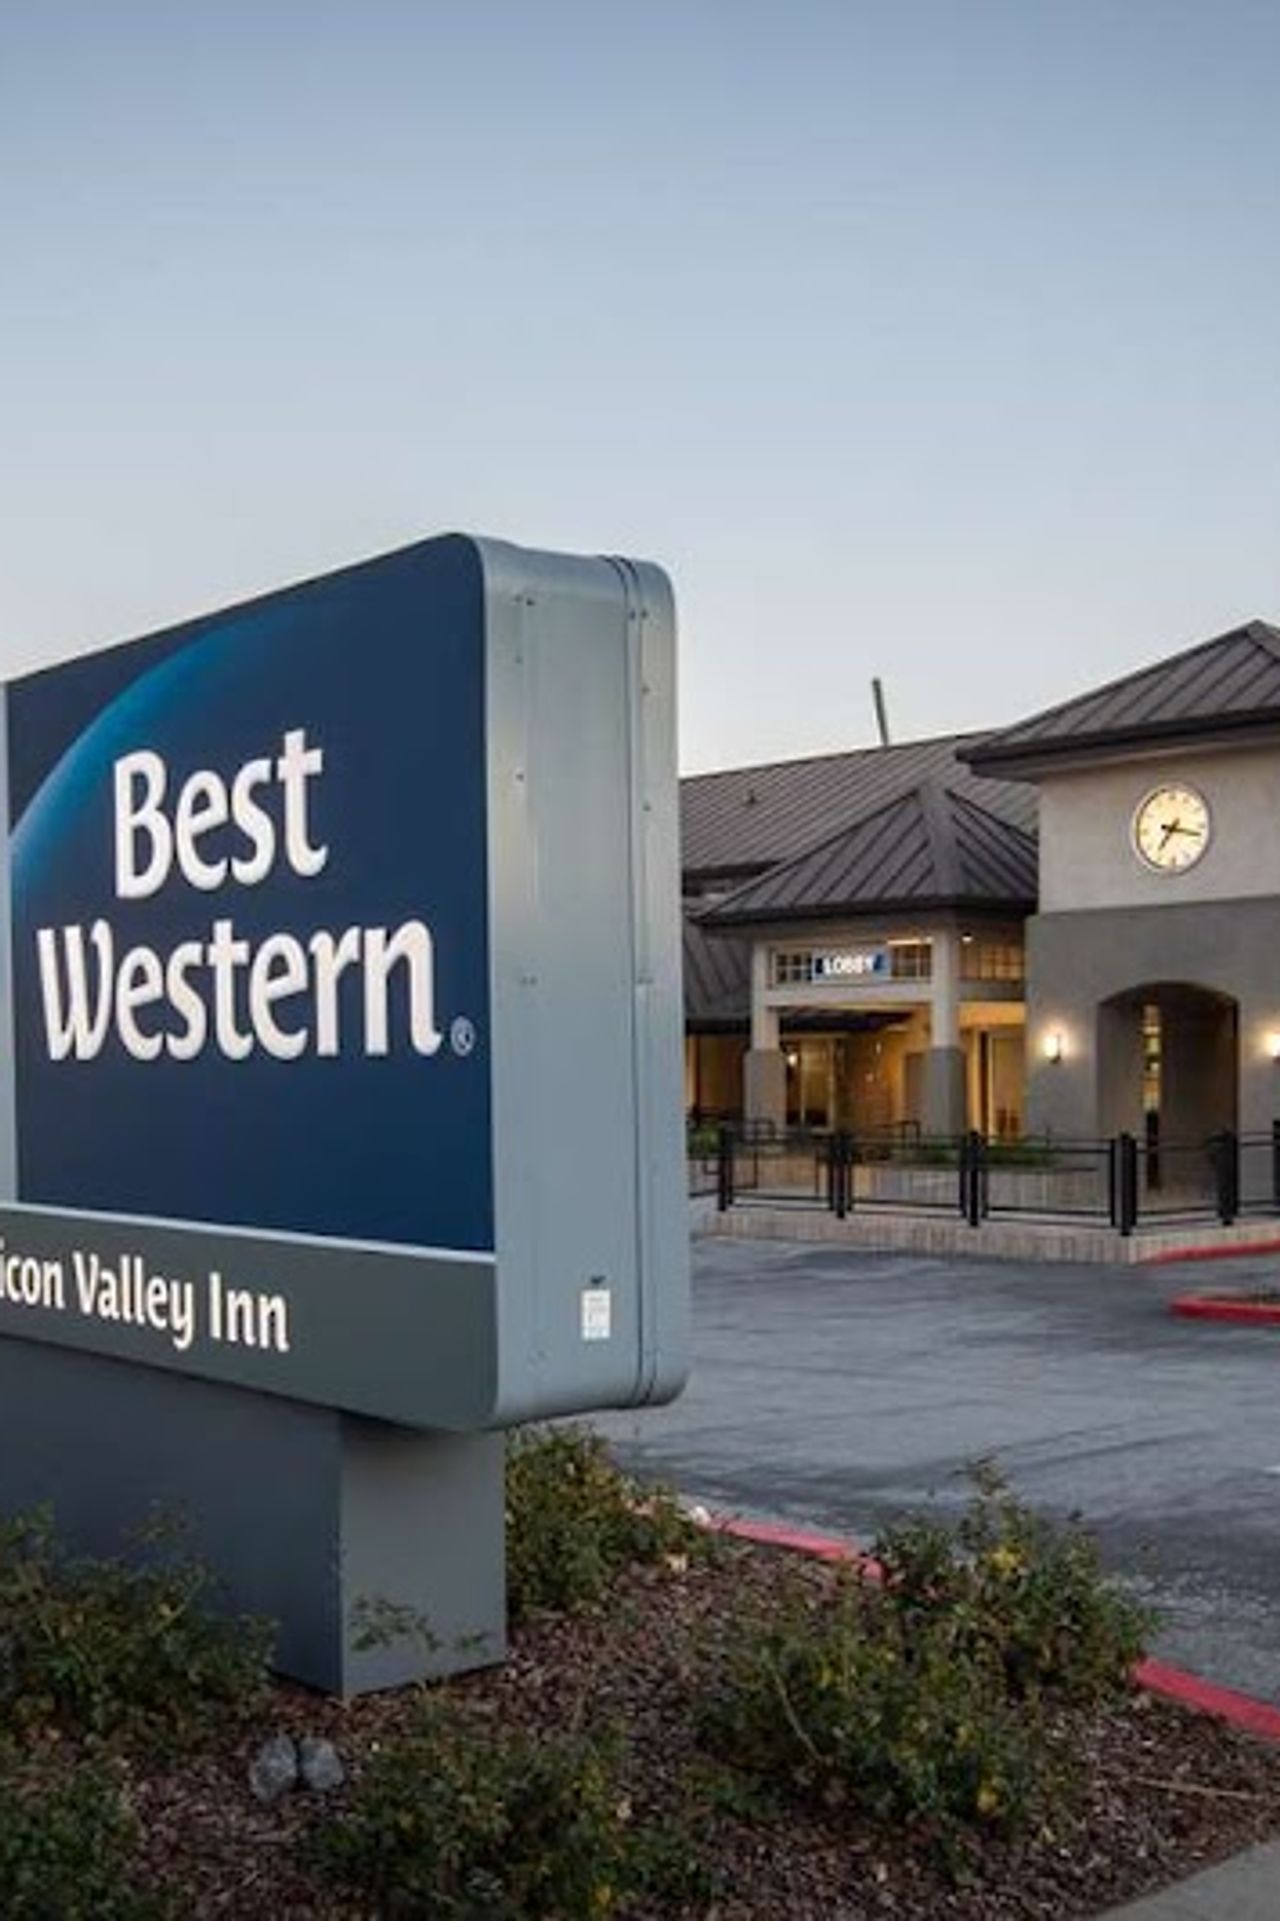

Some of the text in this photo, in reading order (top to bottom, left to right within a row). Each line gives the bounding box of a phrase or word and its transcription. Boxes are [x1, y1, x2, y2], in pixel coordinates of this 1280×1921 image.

[115, 730, 328, 898] Best
[37, 919, 441, 1060] Western
[72, 1251, 194, 1350] Valley
[209, 1271, 290, 1352] Inn
